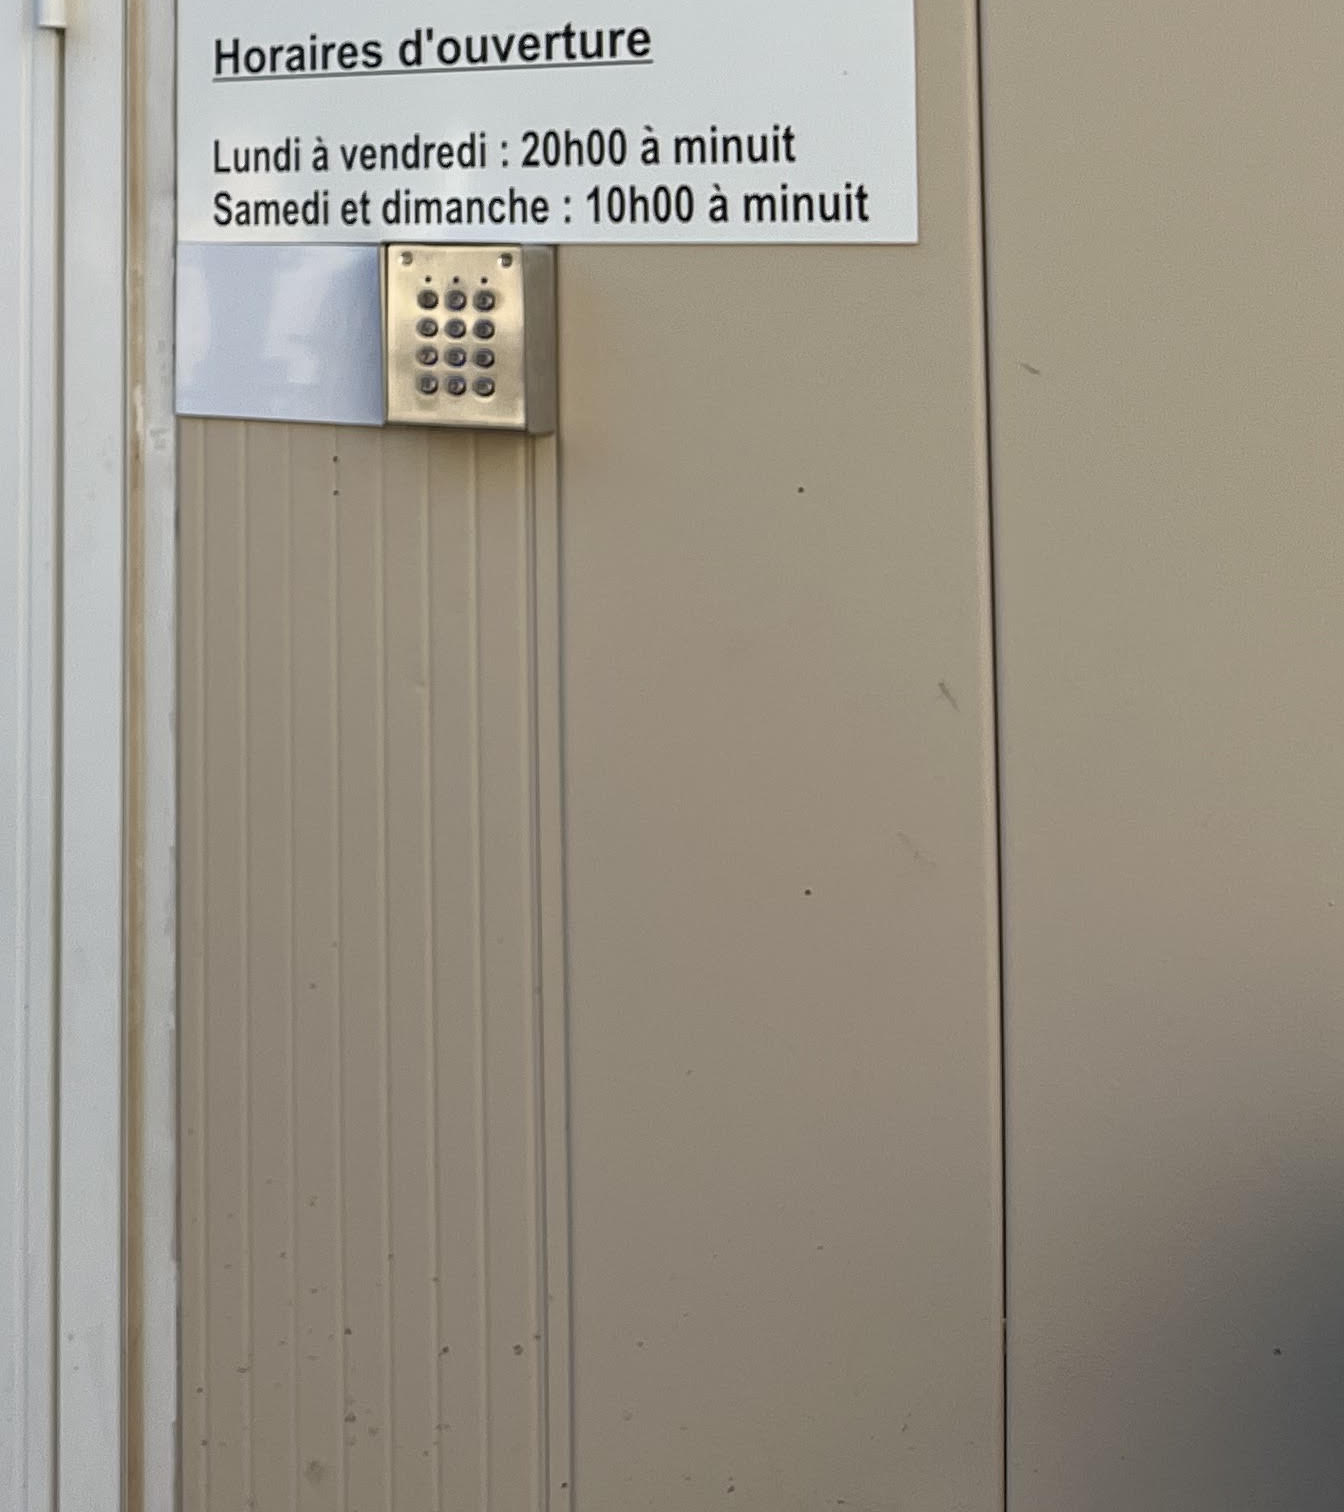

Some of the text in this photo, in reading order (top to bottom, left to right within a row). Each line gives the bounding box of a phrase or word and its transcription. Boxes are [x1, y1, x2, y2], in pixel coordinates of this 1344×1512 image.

[215, 22, 652, 76] Horaires d'ouverture
[214, 136, 300, 174] Lundi
[312, 136, 329, 172] à
[340, 132, 486, 171] vendredi
[521, 128, 627, 168] 20h00
[640, 125, 660, 166] à
[674, 124, 796, 165] minuit
[213, 189, 329, 227] Samedi
[340, 190, 371, 226] et
[382, 188, 550, 226] dimanche
[586, 184, 694, 224] 10h00
[708, 183, 729, 223] à
[743, 181, 870, 223] minuit
